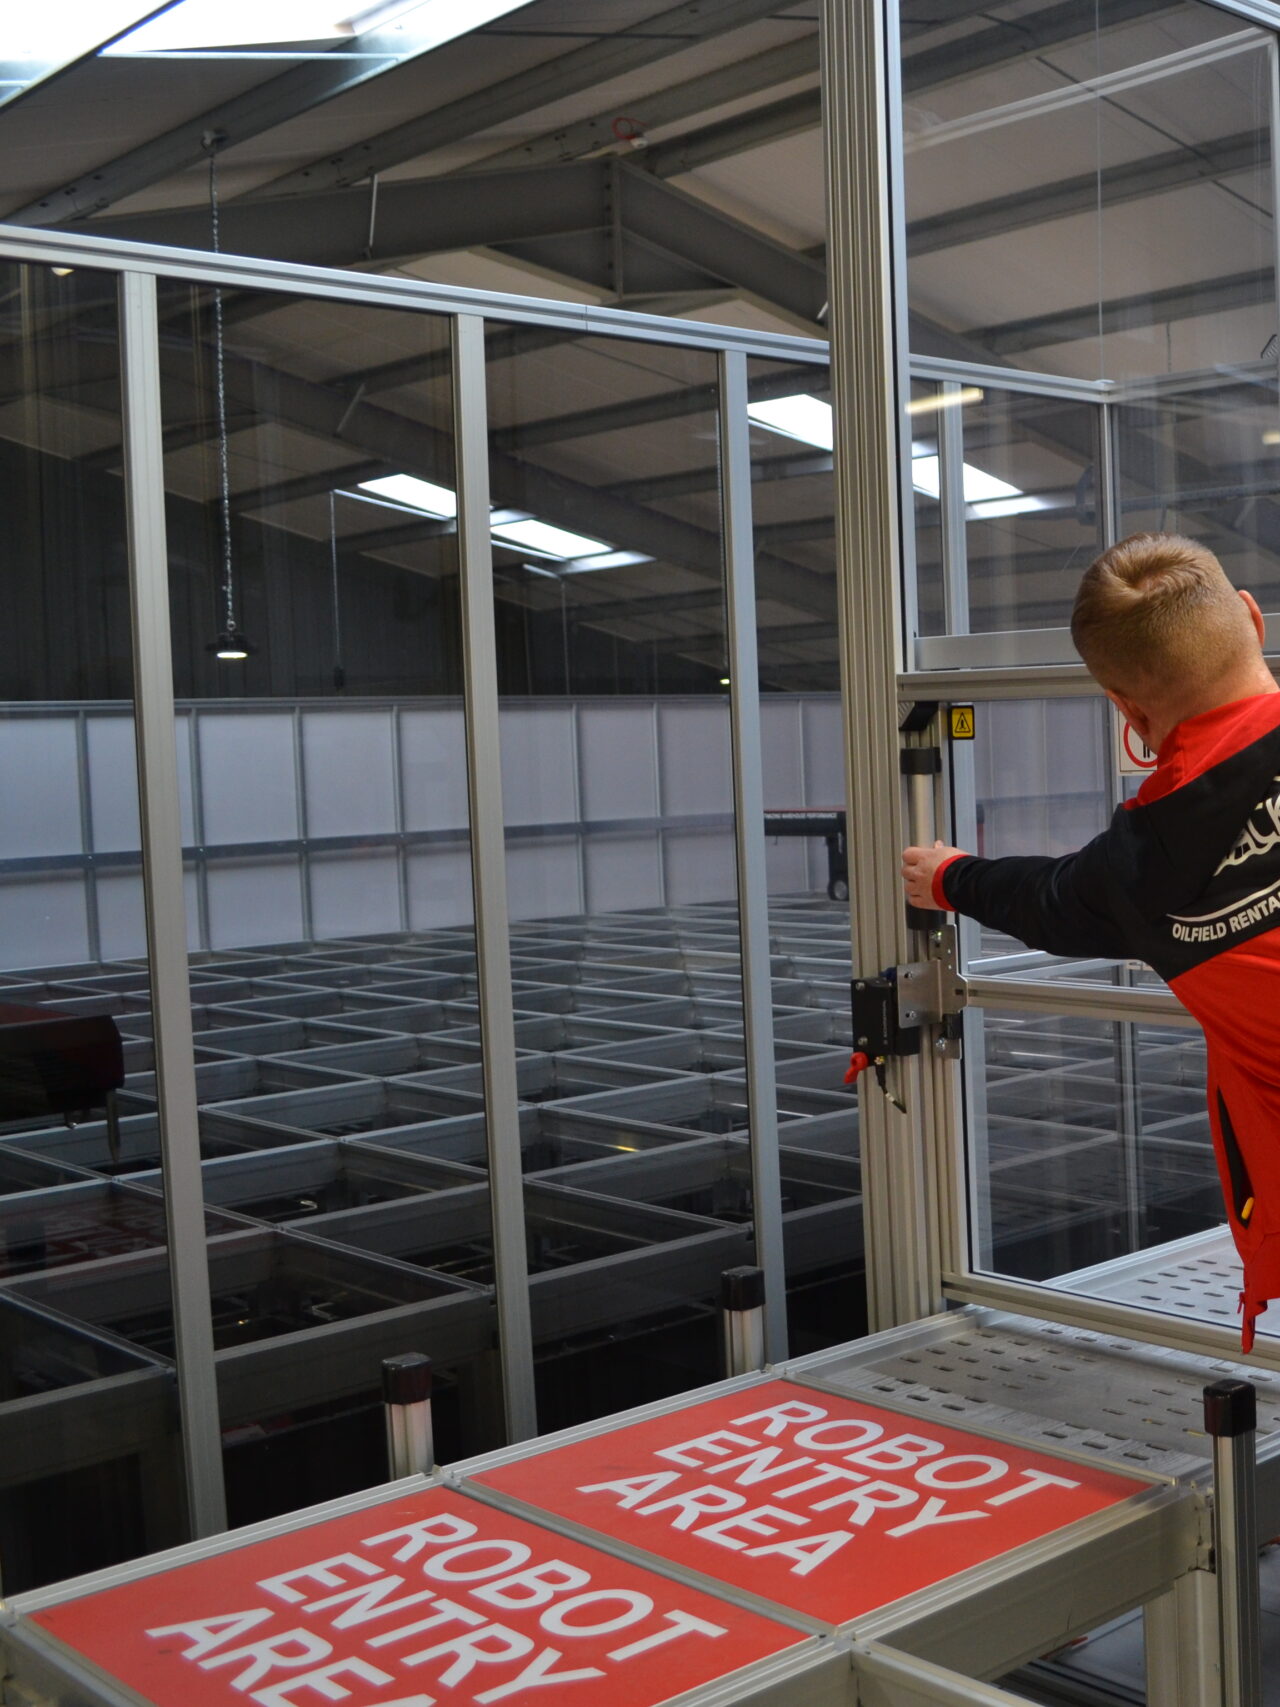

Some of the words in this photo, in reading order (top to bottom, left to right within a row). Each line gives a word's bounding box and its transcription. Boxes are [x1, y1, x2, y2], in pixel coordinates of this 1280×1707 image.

[1172, 923, 1227, 943] OILFIELD
[652, 1429, 991, 1539] ENTRY
[728, 1399, 1082, 1507] ROBOT
[575, 1470, 856, 1577] AREA
[255, 1551, 607, 1706] ENTRY
[359, 1512, 729, 1663] ROBOT
[144, 1607, 437, 1707] ARE
